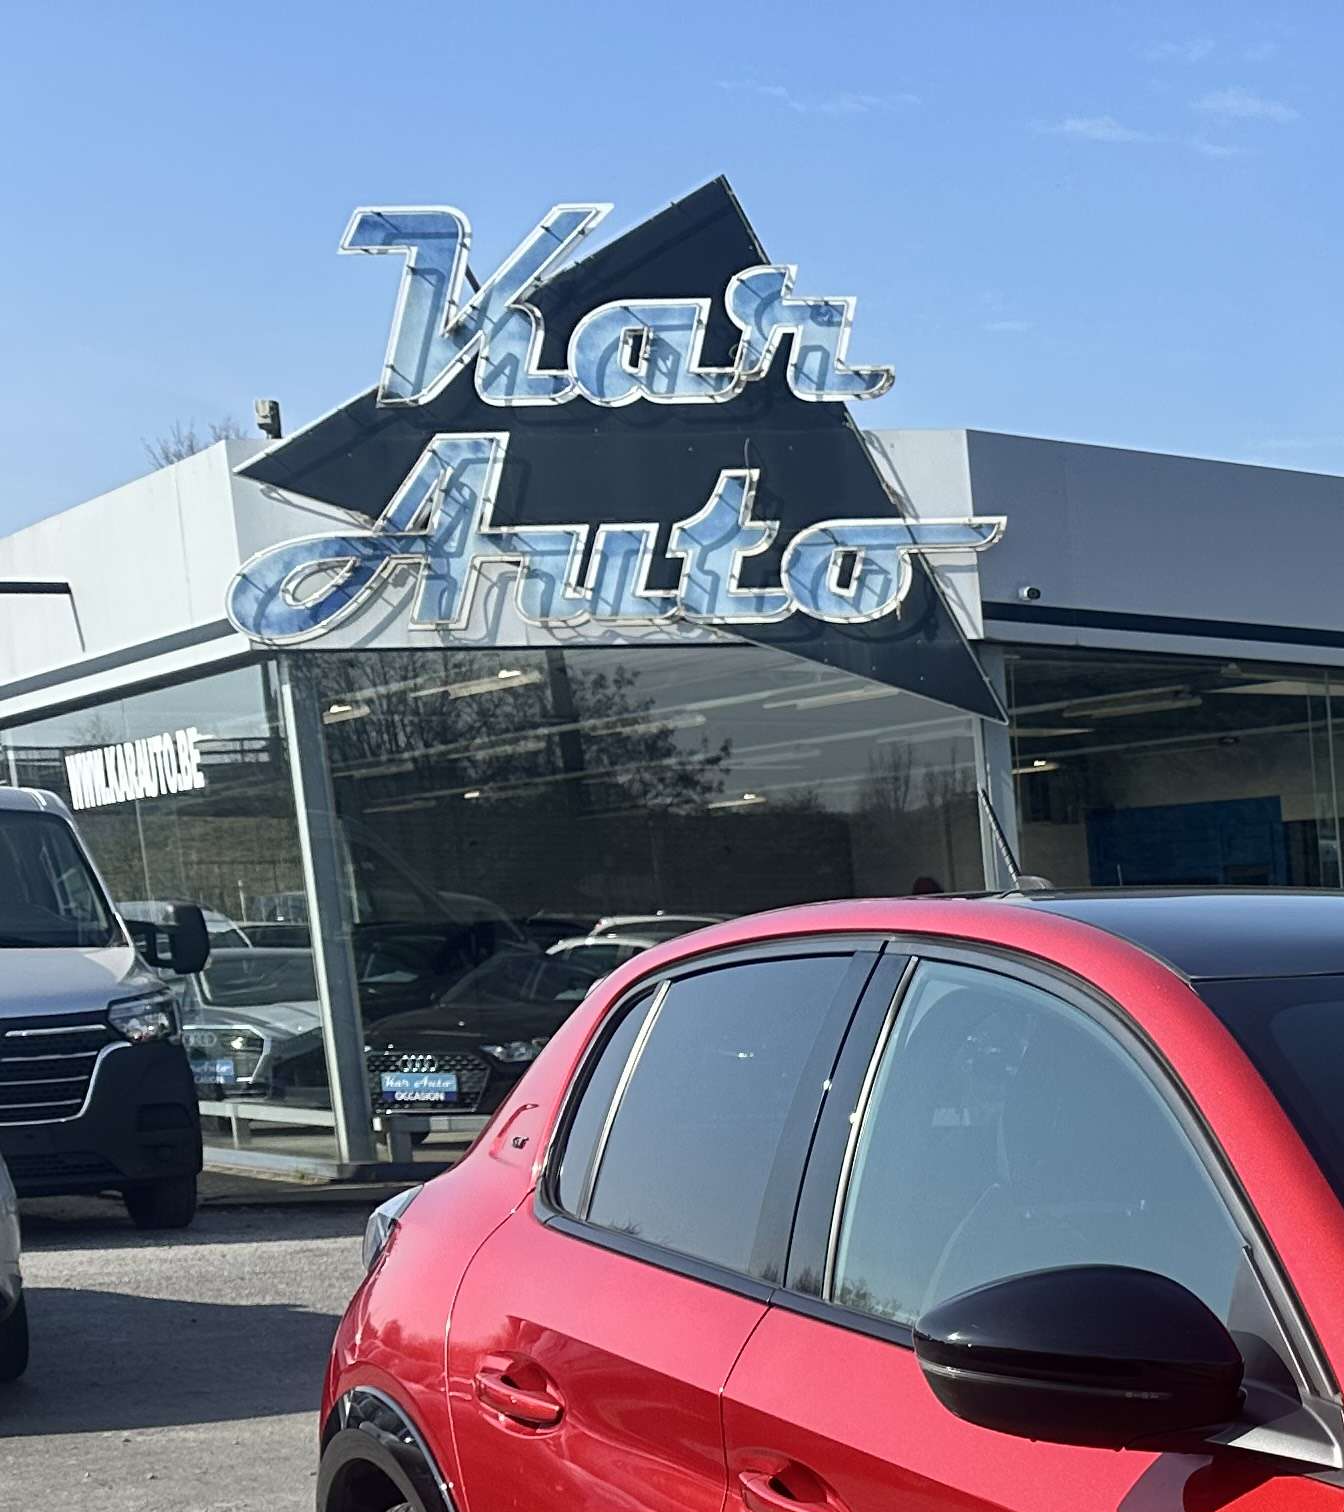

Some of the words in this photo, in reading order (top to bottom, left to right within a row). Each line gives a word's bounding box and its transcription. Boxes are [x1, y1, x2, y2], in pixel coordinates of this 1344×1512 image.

[337, 202, 896, 408] Kar
[225, 431, 1008, 646] Auto
[64, 727, 206, 811] WWW.KARAUTO.BE
